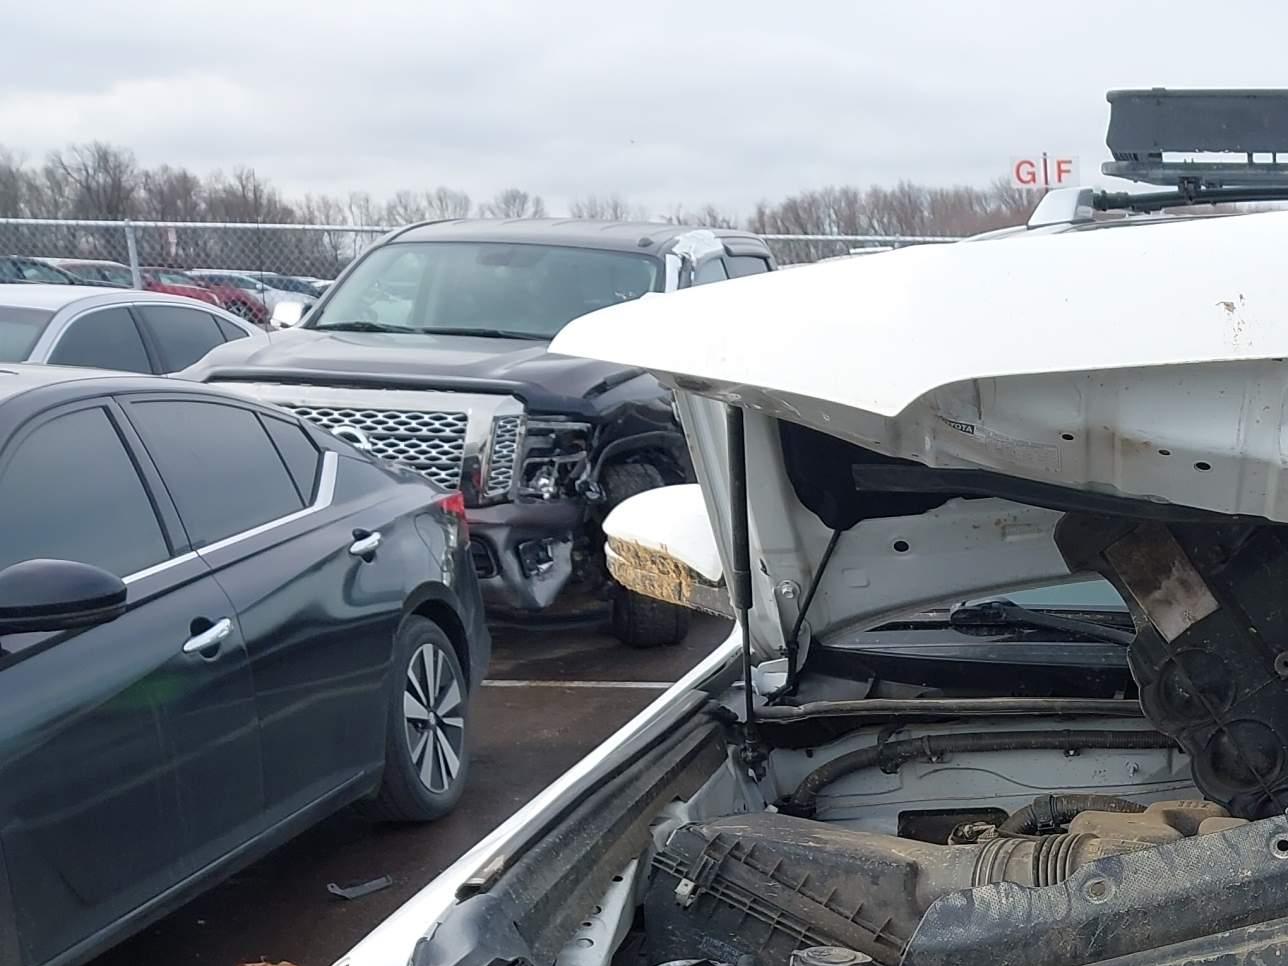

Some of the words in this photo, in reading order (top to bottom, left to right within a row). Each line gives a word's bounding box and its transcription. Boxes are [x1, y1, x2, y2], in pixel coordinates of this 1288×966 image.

[1015, 159, 1036, 185] G
[1056, 159, 1073, 183] F
[944, 419, 973, 434] YOTA
